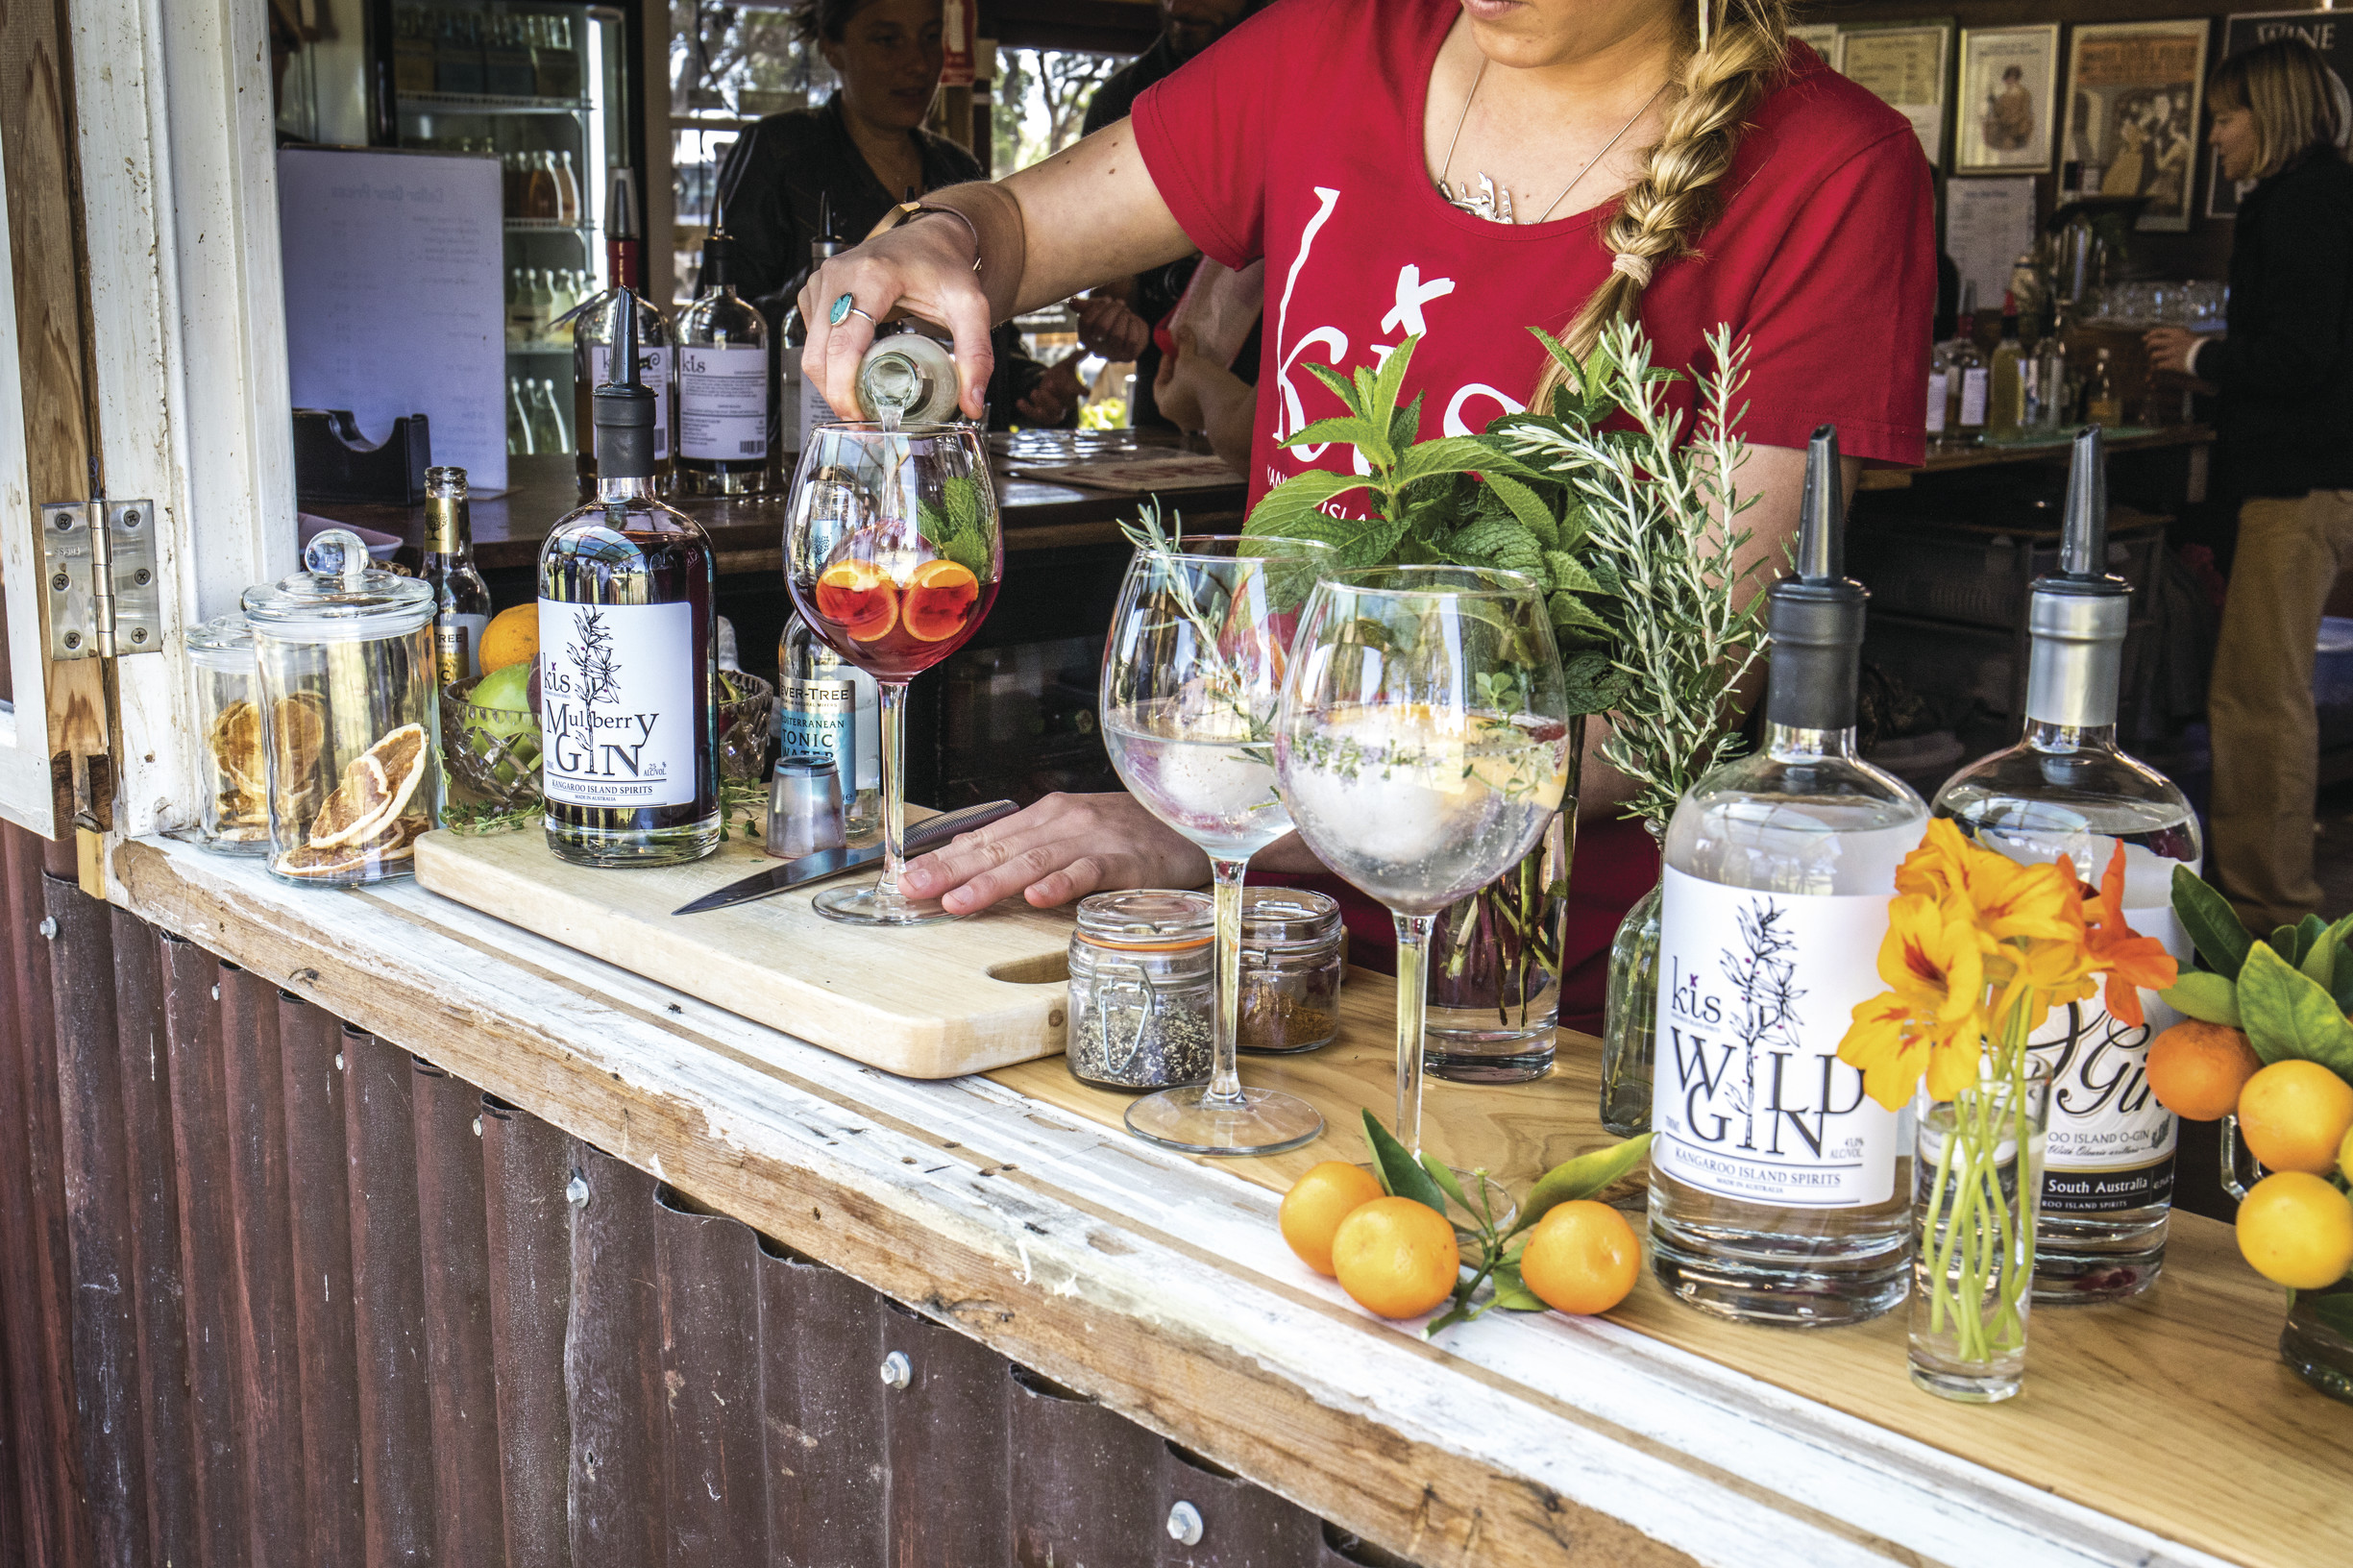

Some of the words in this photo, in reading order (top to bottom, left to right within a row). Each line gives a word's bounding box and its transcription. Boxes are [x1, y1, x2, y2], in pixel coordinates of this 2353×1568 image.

[682, 350, 705, 373] kis
[543, 652, 571, 694] kis
[546, 698, 659, 749] Mulberry
[782, 728, 833, 747] TONIC
[555, 732, 639, 777] GIN
[551, 779, 586, 793] KANGAROO
[587, 786, 618, 795] ISLAND
[620, 786, 653, 795] SPIRITS
[1672, 955, 1721, 1023] kis
[1670, 1025, 1865, 1115] WILD
[1686, 1081, 1824, 1159] GIN
[2073, 1132, 2117, 1143] ISLAND
[2120, 1130, 2149, 1143] O-GIN
[1675, 1147, 1735, 1176] KANGAROO
[1739, 1166, 1787, 1183] ISLAND
[1791, 1174, 1841, 1186] SPIRITS
[1745, 1183, 1783, 1193] AUSTRALIA
[2047, 1179, 2090, 1193] South
[2095, 1177, 2148, 1193] Australia
[2066, 1201, 2097, 1210] ISLAND
[2099, 1200, 2127, 1210] SPIRITS
